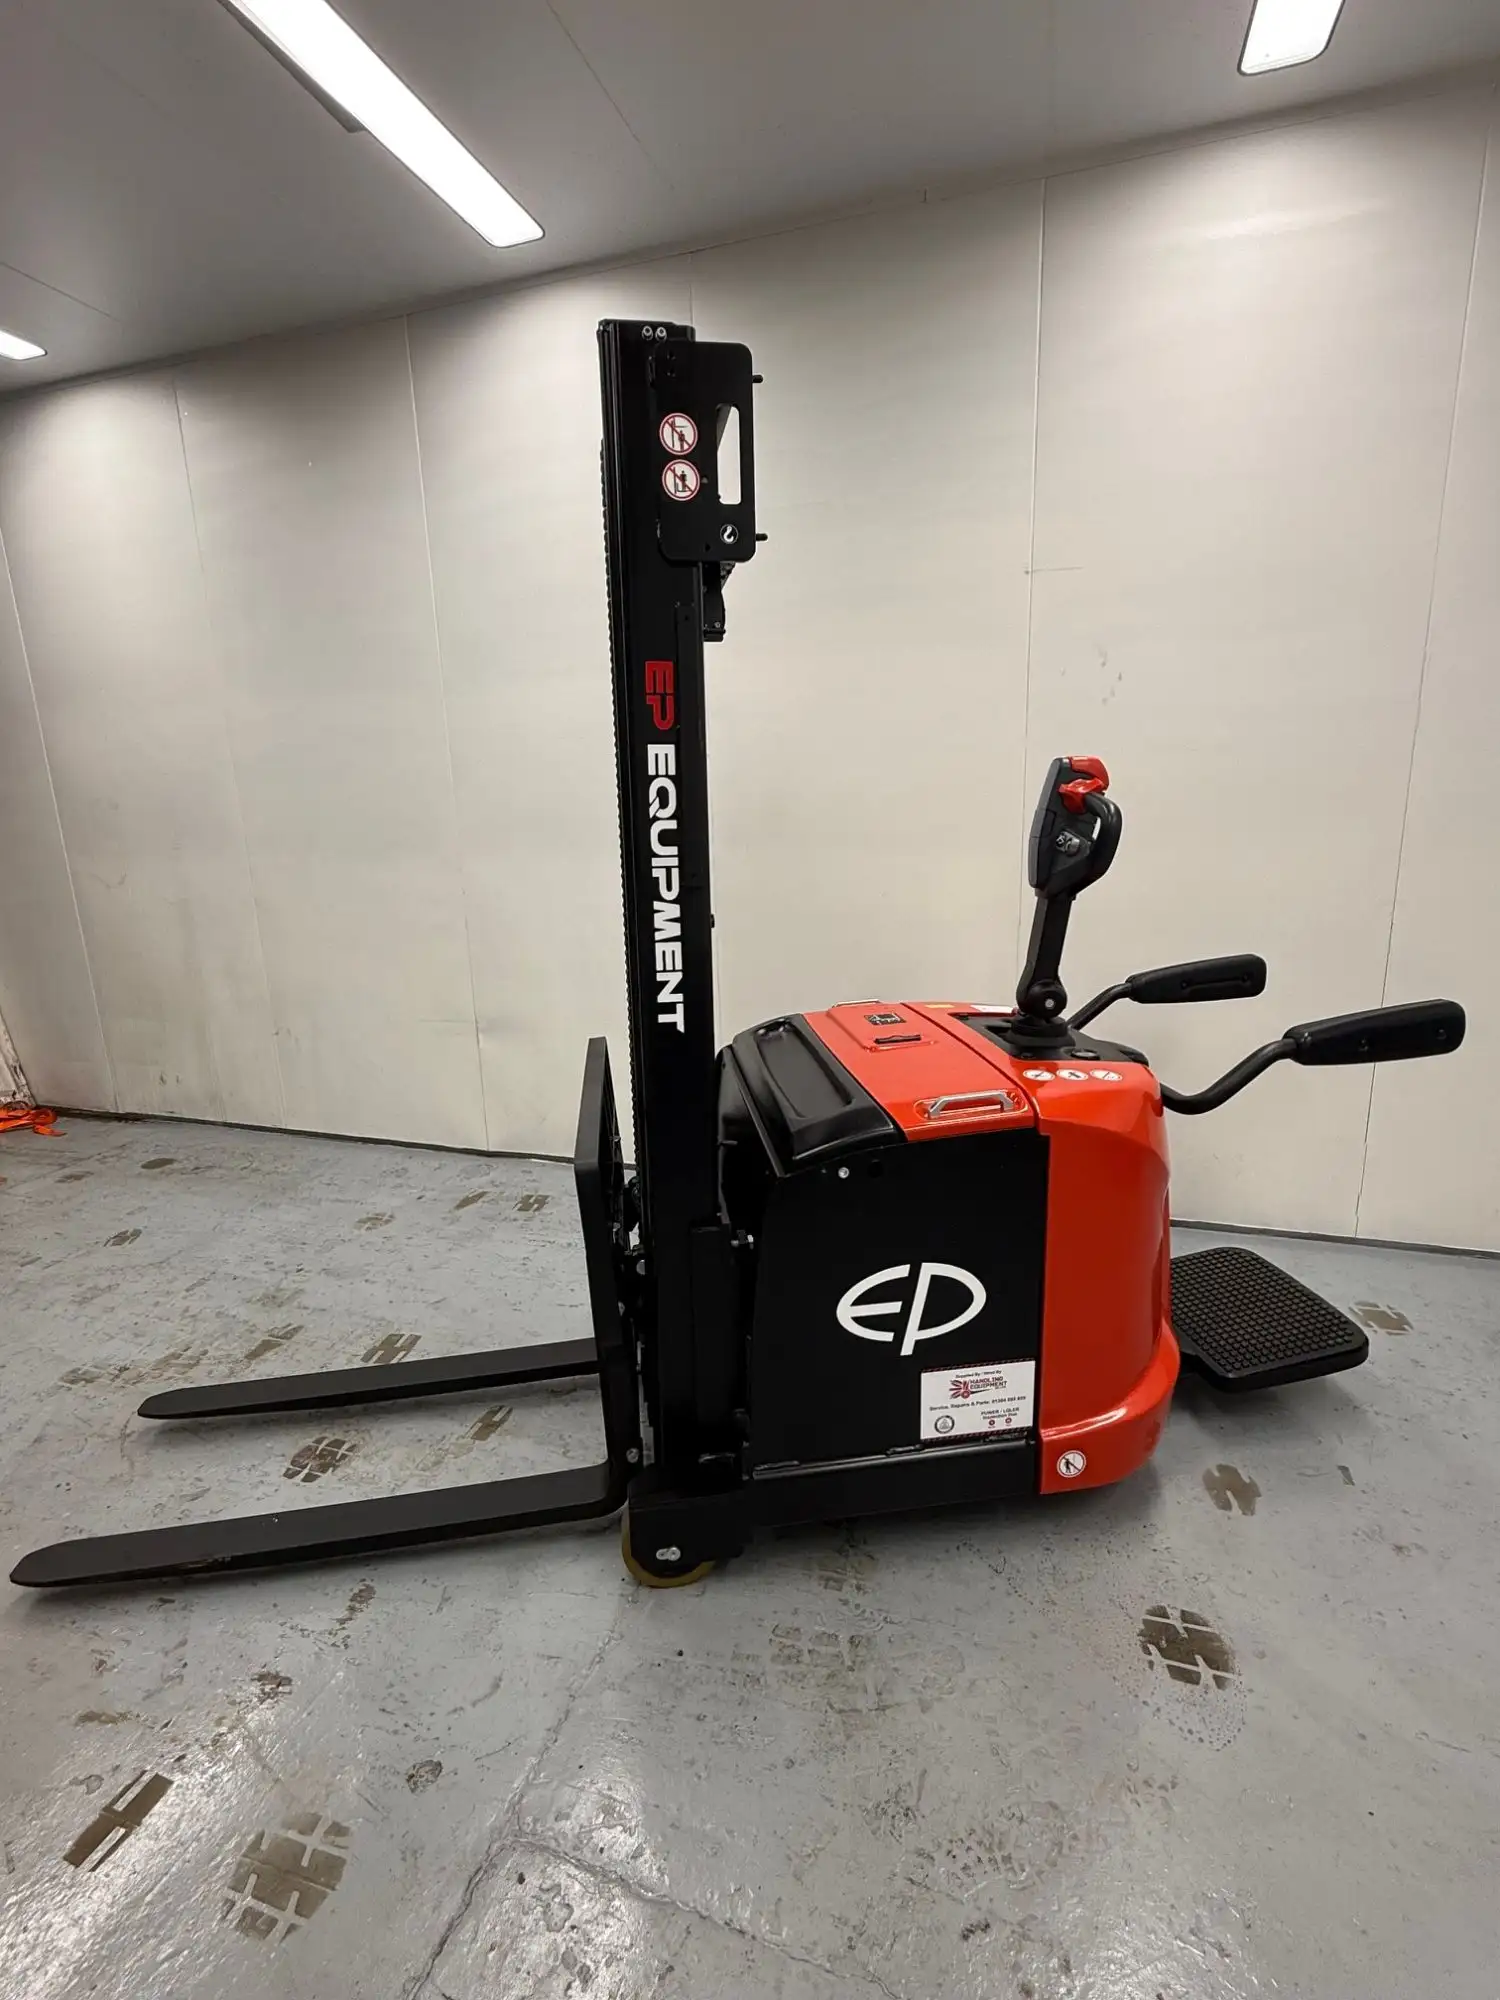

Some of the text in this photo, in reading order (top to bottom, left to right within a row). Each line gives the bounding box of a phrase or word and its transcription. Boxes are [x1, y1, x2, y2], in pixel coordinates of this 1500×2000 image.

[645, 660, 685, 1033] EP EQUIPMENT
[836, 1262, 987, 1356] EP
[970, 1376, 1004, 1385] HANDLING
[970, 1380, 1008, 1390] EQUIPMENT
